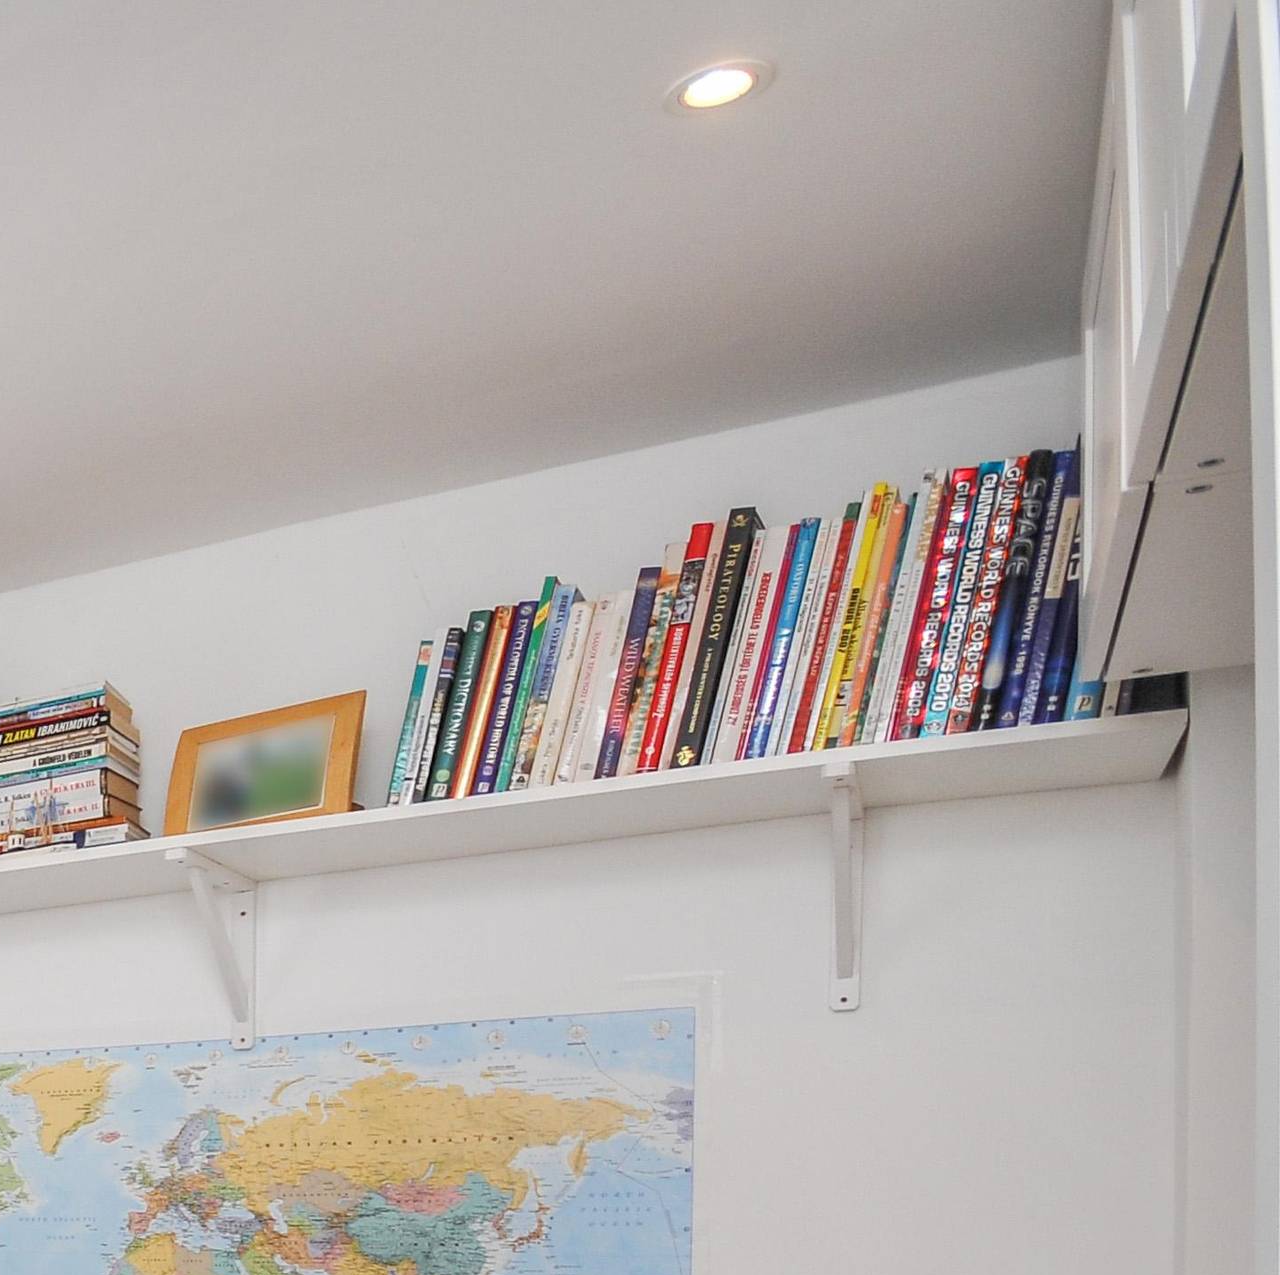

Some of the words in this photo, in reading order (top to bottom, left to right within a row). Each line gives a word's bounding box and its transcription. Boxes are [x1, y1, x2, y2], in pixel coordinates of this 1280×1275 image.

[942, 479, 970, 555] GUINNESS
[968, 471, 998, 550] GUINNESS
[992, 465, 1022, 545] GUINNESS
[1005, 474, 1048, 580] SPACE
[708, 541, 741, 641] PIRATEOLOGY
[930, 555, 953, 609] WORLD
[956, 548, 980, 604] WORLD
[981, 546, 1004, 599] WORLD
[845, 586, 859, 627] ANNUAL
[964, 600, 991, 674] RECORDS
[625, 635, 640, 673] WILD
[916, 610, 942, 678] RECORDS
[941, 603, 968, 673] RECORDS
[443, 676, 471, 756] DICTIONARY
[495, 696, 508, 727] WORLD
[610, 674, 631, 735] WEATHER
[931, 671, 952, 713] 2010
[955, 672, 975, 711] 2014
[3, 727, 37, 744] ZLATAN
[37, 714, 100, 738] IBRAHIMOVIĆ
